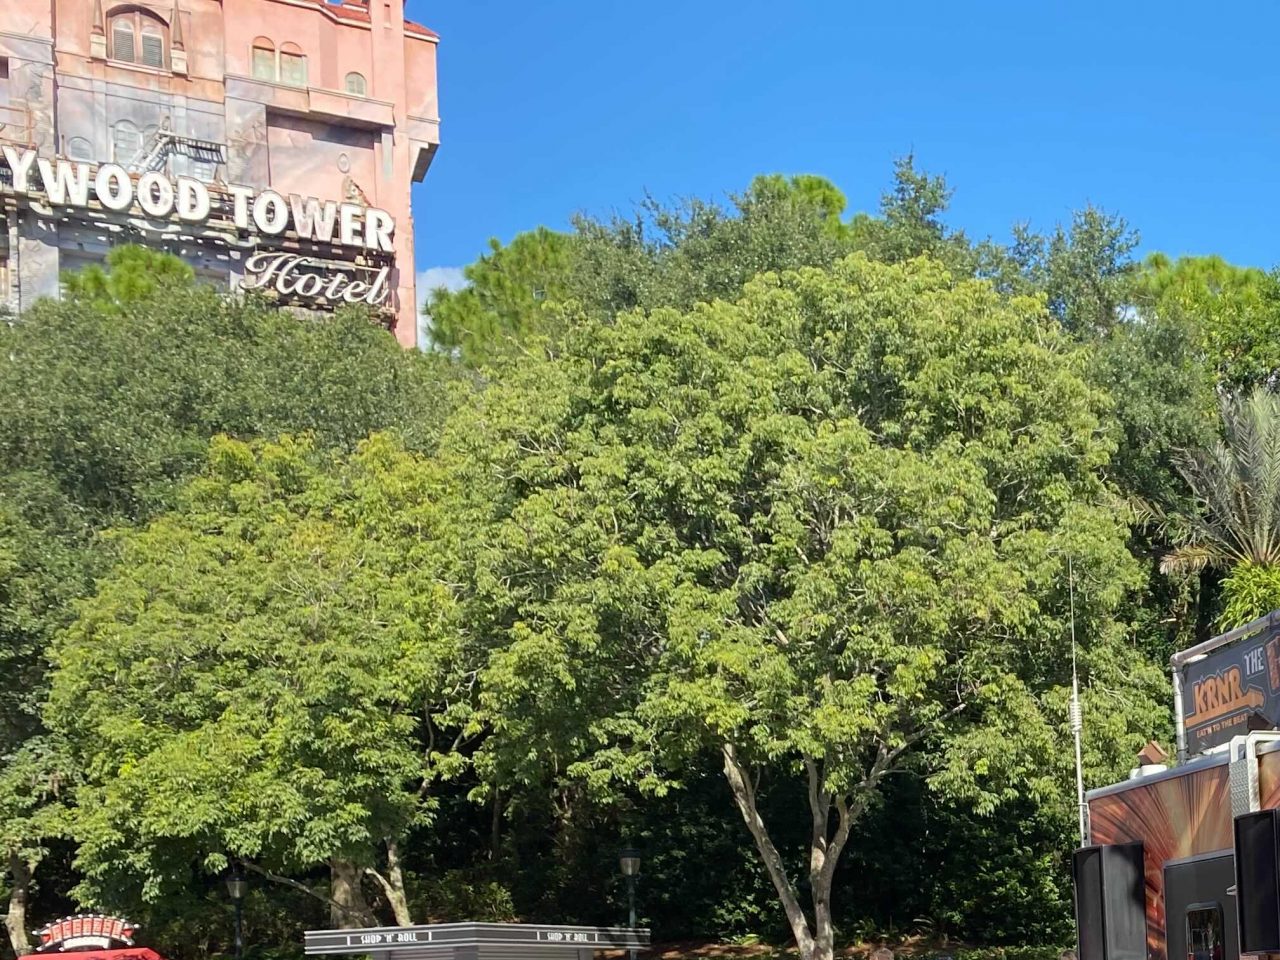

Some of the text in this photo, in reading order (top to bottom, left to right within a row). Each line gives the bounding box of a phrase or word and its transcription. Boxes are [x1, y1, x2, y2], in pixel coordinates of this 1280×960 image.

[228, 184, 395, 253] TOWER
[240, 252, 389, 305] Hotel
[1244, 647, 1265, 677] THE
[1193, 666, 1244, 715] KRNR
[1221, 717, 1233, 729] THE
[360, 934, 382, 944] SHOP
[397, 932, 418, 942] ROLL
